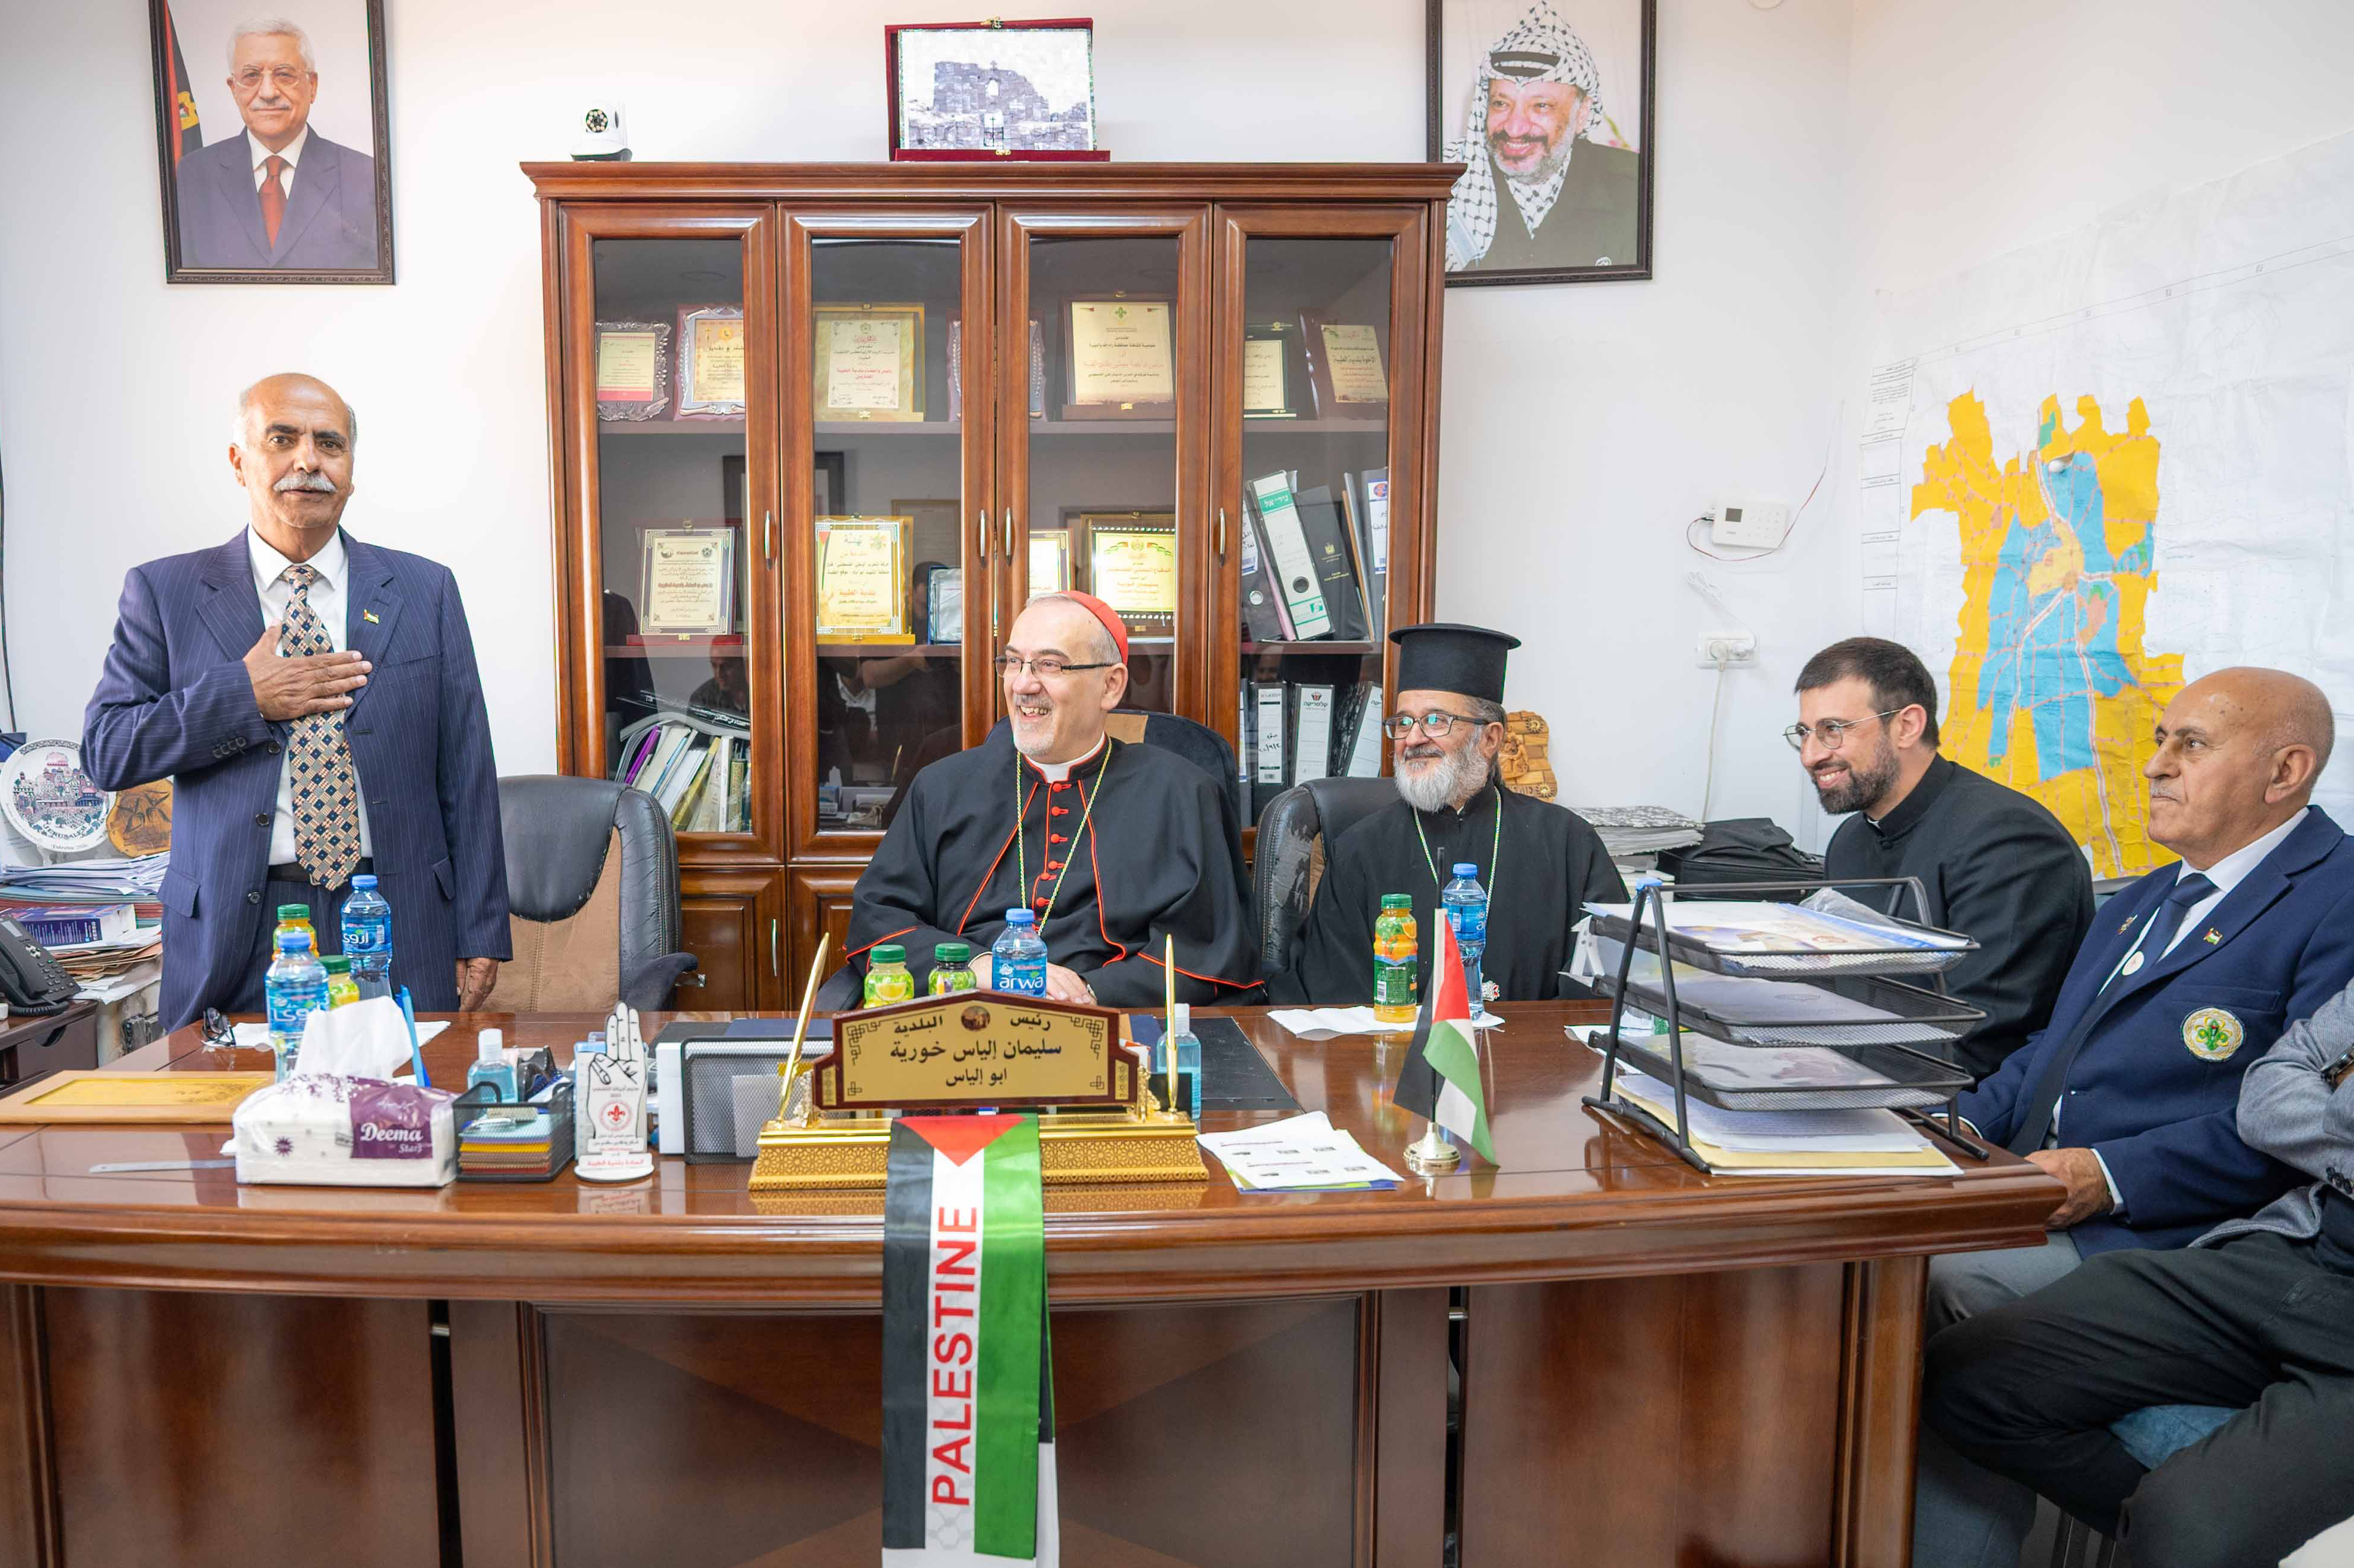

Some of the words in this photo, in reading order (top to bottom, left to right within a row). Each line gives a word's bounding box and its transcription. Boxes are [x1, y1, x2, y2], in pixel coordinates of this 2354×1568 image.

[43, 824, 87, 840] JERUSALEM
[999, 975, 1043, 990] arwa
[894, 1015, 944, 1037] البلدية
[1010, 1012, 1051, 1031] رئيس
[890, 1040, 946, 1063] خورية
[953, 1039, 997, 1062] إلياس
[1003, 1038, 1061, 1060] سليمان
[945, 1067, 983, 1087] إلياس
[988, 1067, 1007, 1087] ابو
[360, 1122, 424, 1142] Deema
[932, 1206, 978, 1506] PALESTINE
